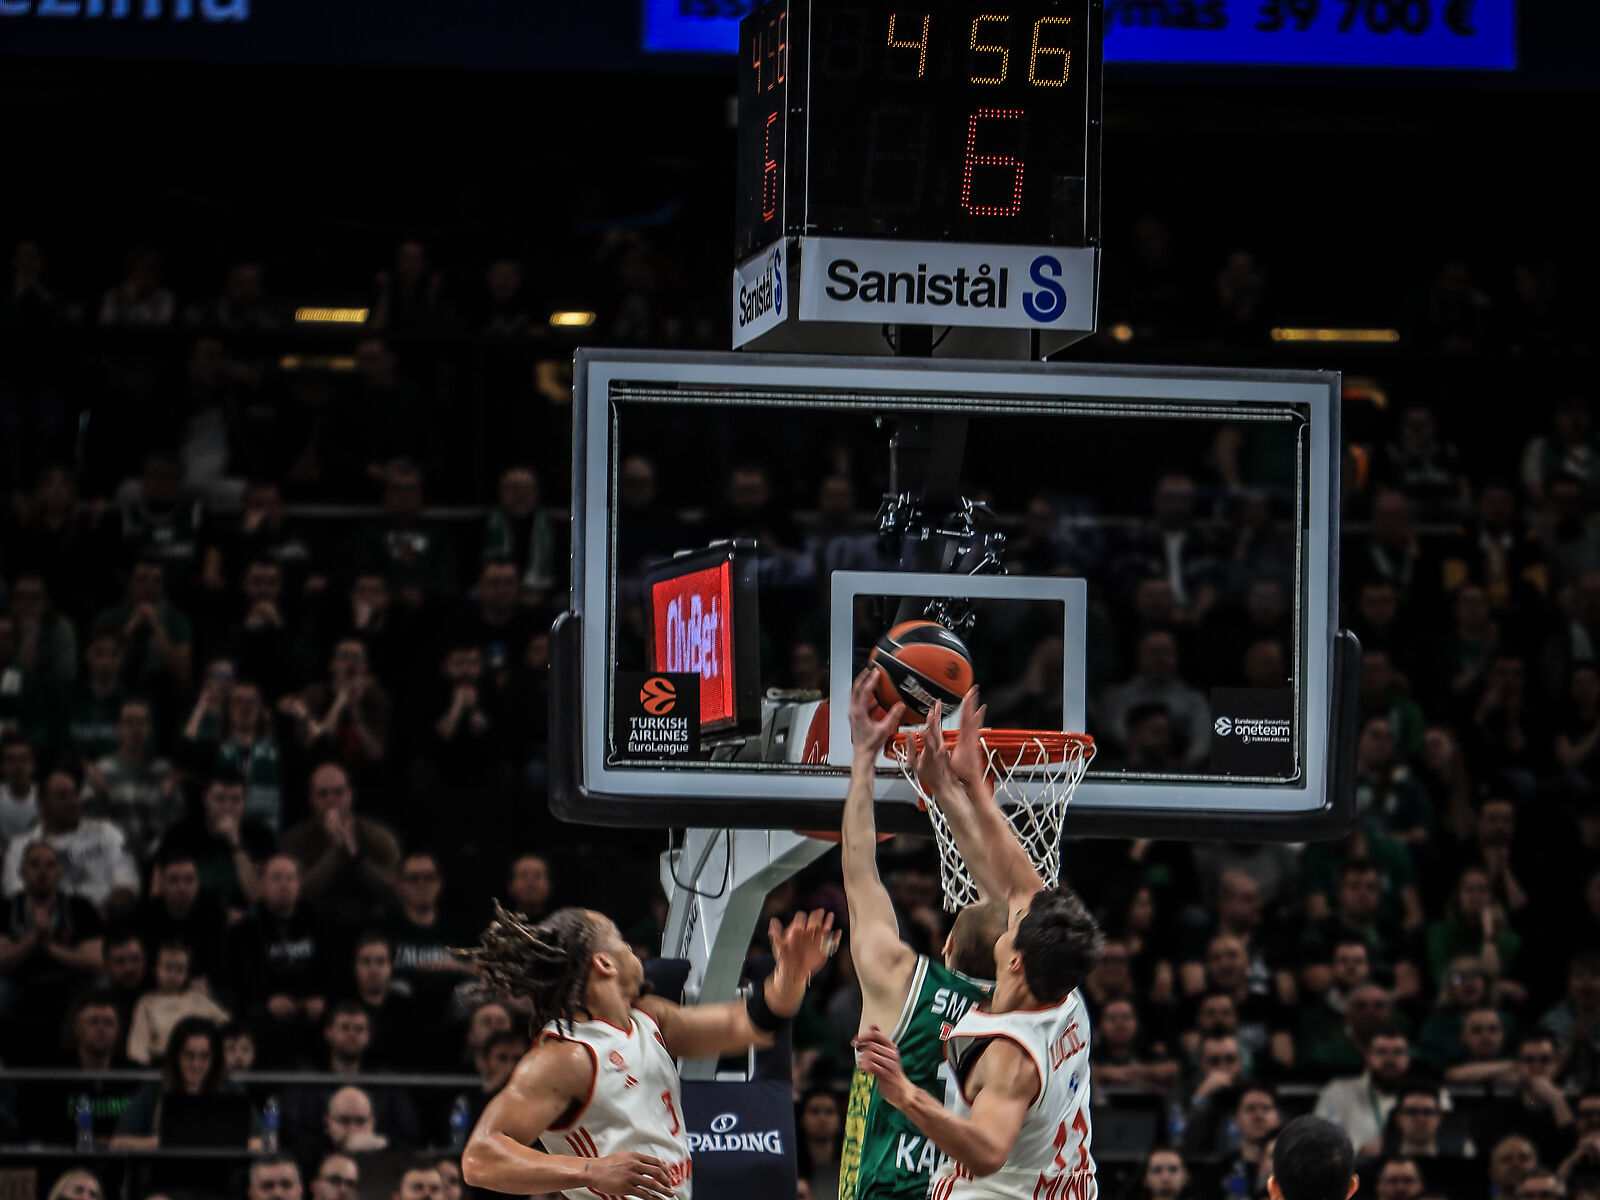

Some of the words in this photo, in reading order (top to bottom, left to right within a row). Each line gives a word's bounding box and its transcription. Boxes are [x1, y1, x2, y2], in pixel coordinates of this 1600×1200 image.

[961, 108, 1025, 217] 6
[825, 258, 1009, 310] Sanistål
[739, 266, 773, 328] Sanistål
[629, 716, 688, 730] TURKISH
[1234, 723, 1290, 737] oneteam
[629, 729, 689, 742] AIRLINES
[628, 741, 690, 756] EuroLeague
[686, 1130, 784, 1155] PALDING
